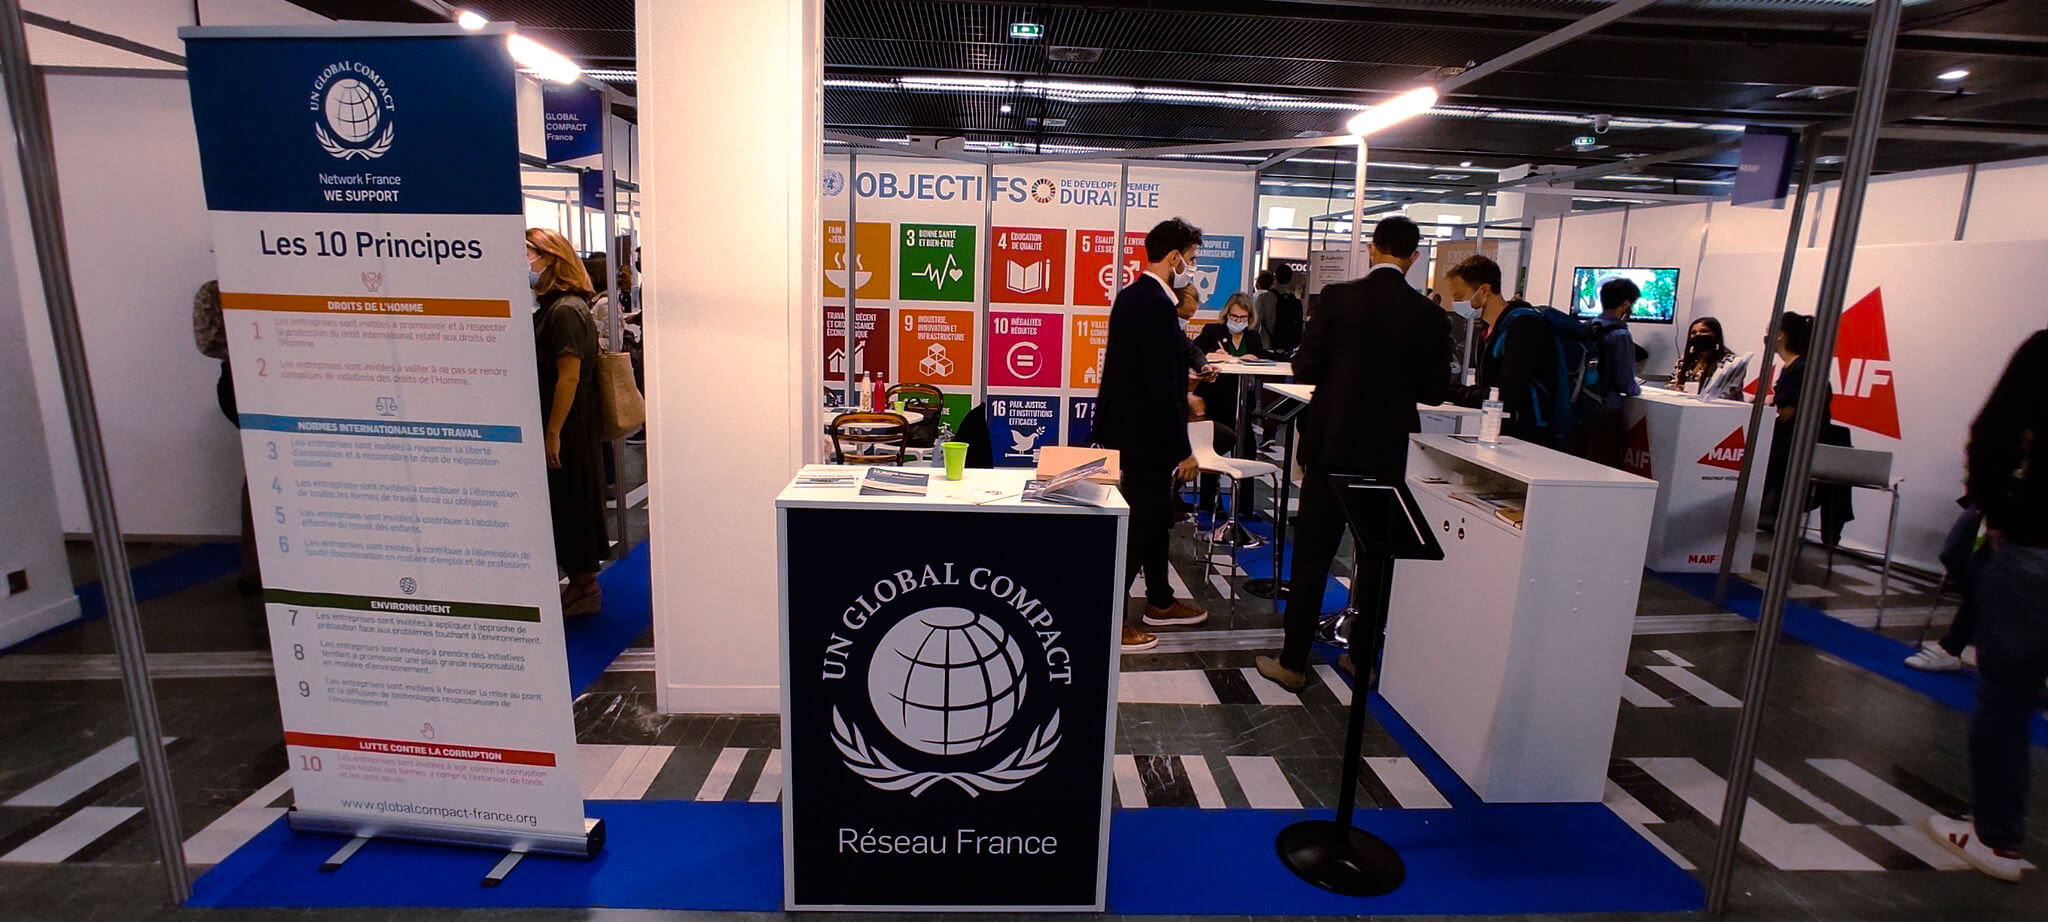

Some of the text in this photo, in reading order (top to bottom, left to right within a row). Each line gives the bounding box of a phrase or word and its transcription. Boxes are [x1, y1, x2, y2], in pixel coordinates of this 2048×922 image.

[310, 60, 395, 112] UN GLOBAL COMPACT
[546, 112, 580, 120] GLOBAL
[546, 122, 588, 131] COMPACT
[546, 132, 574, 141] France
[319, 173, 401, 185] Network France
[1060, 180, 1072, 188] DE
[856, 172, 1028, 203] OBJECTIFS
[324, 190, 400, 202] WE SUPPORT
[1060, 188, 1159, 208] DURABLE
[906, 229, 956, 247] 3 BONNE SANTÉ
[998, 232, 1042, 250] 4 ÉDUCATION
[1012, 242, 1042, 250] DE QUALITÉ
[1082, 236, 1090, 252] 5
[260, 230, 482, 265] Les 10 Principes
[328, 301, 424, 312] DROITS DE L'HOMME
[856, 313, 877, 322] DÉCENT
[904, 315, 914, 332] 9
[252, 322, 262, 340] 1
[466, 322, 506, 333] respecter
[918, 324, 950, 332] INNOVATION
[994, 318, 1042, 334] 10 INÉGALITÉS
[1011, 327, 1037, 336] RÉDUITES
[1077, 320, 1088, 336] 11
[918, 332, 965, 342] INFRASTRUCTURE
[256, 358, 267, 377] 2
[992, 400, 1006, 416] 16
[1016, 410, 1053, 418] INSTITUTIONS
[1075, 403, 1088, 418] 17
[298, 422, 482, 438] NORMES INTERNATIONALES DU TRAVAIL
[1008, 418, 1038, 426] EFFICACES
[267, 442, 278, 460] 3
[1624, 448, 1650, 468] AIF
[1708, 448, 1744, 461] MAIF
[272, 478, 282, 494] 4
[276, 506, 286, 524] 5
[280, 536, 289, 552] 6
[1688, 555, 1716, 564] MAIF
[371, 600, 450, 613] ENVIRONNEMENT
[288, 610, 298, 626] 7
[823, 562, 1072, 685] UN GLOBAL COMPACT
[294, 644, 304, 660] 8
[299, 680, 310, 698] 9
[360, 742, 502, 760] LUTTE CONTRE LA CORRUPTION
[300, 756, 322, 772] 10
[340, 799, 538, 826] www.globalcompact-france.org
[838, 828, 1058, 854] Réseau France
